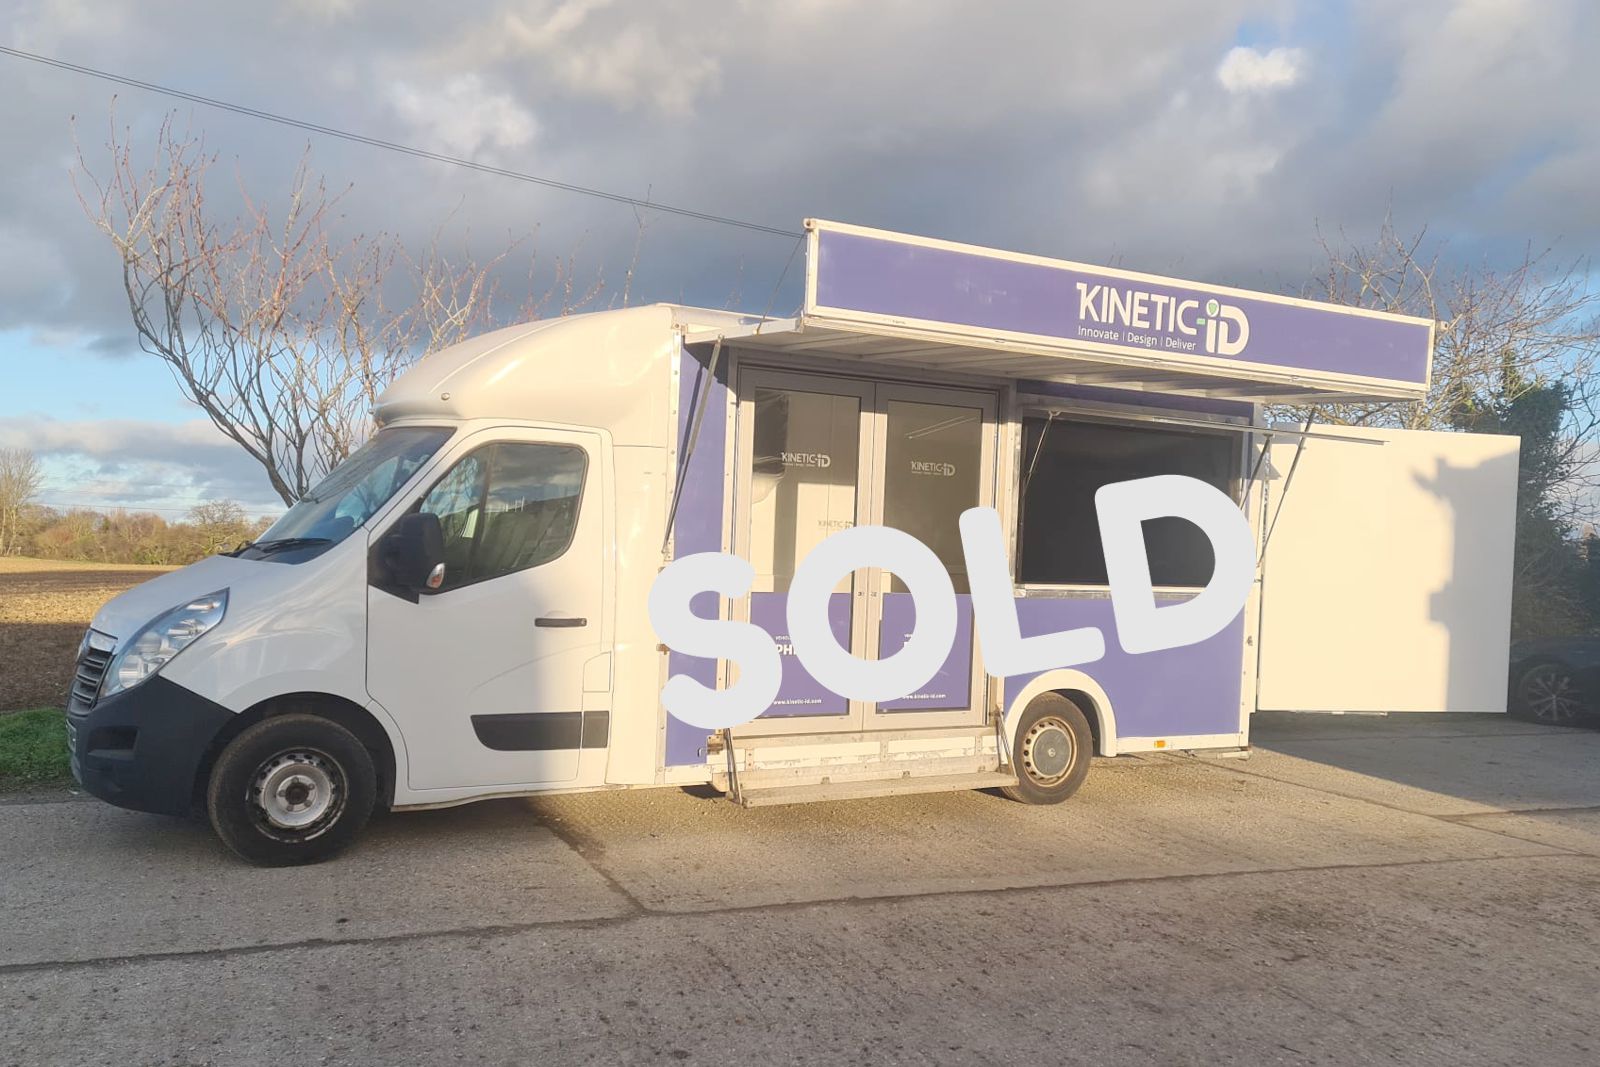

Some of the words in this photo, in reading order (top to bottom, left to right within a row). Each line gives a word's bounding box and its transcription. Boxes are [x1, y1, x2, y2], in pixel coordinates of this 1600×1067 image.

[1078, 325, 1119, 341] Innovate
[1127, 332, 1158, 348] Design
[1165, 337, 1197, 351] Deliver
